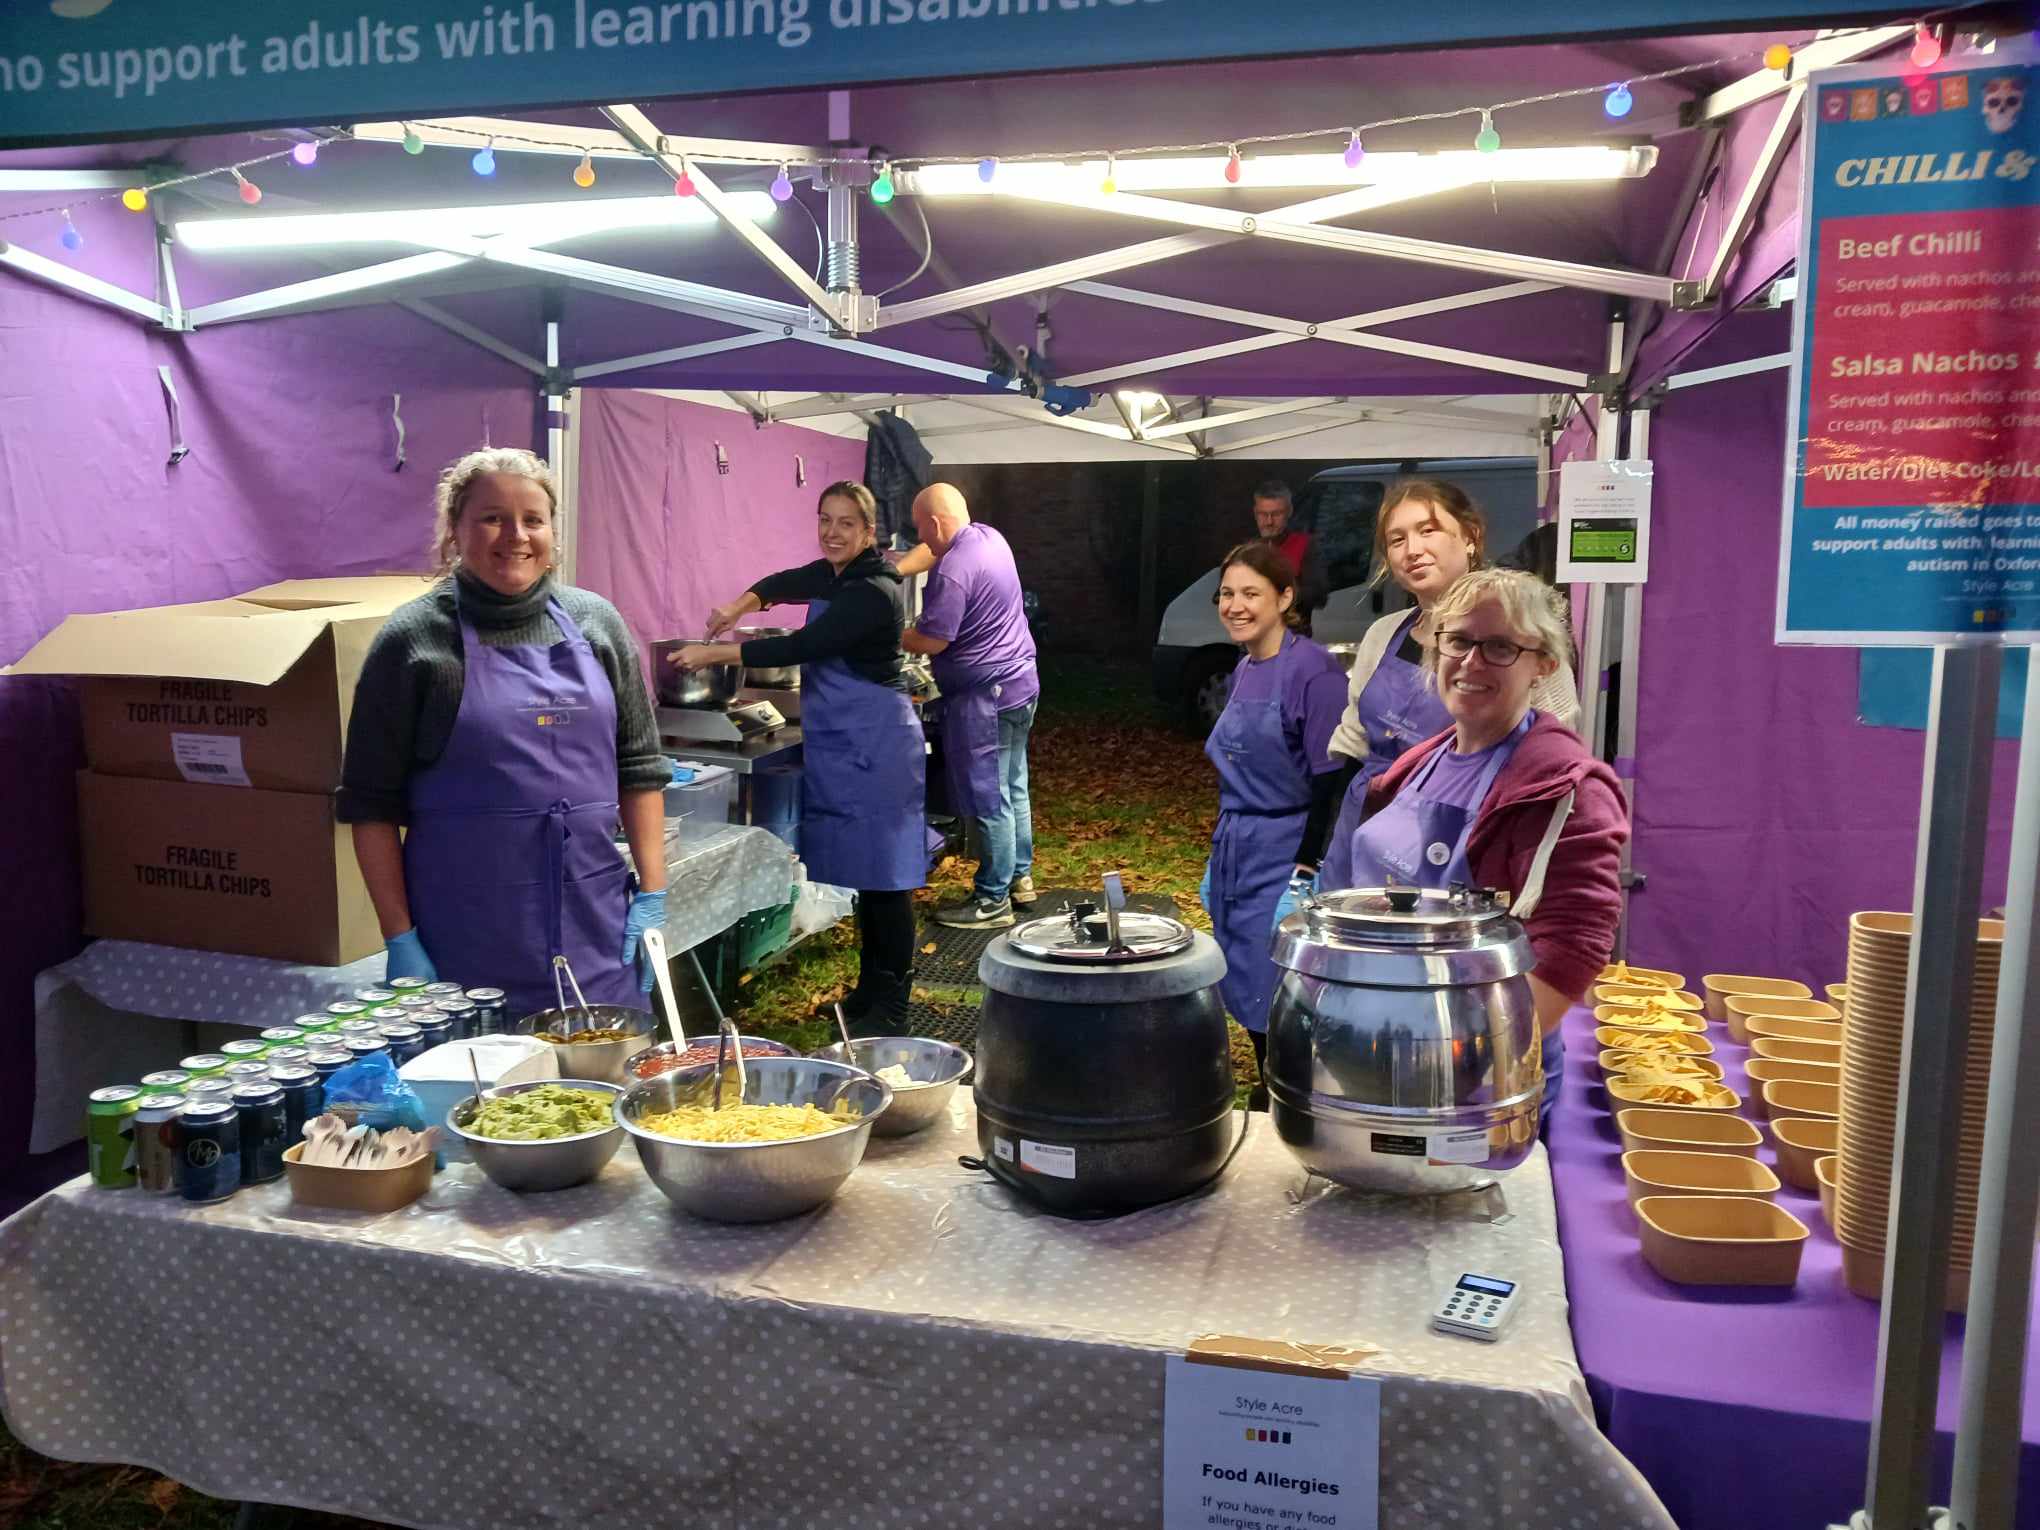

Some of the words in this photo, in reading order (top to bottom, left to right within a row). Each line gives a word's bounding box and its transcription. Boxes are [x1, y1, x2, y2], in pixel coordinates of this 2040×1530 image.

[58, 33, 247, 98] support
[261, 17, 420, 73] adults
[435, 2, 556, 59] with
[575, 0, 812, 48] learning
[1835, 151, 1993, 188] CHILLI
[1995, 150, 2038, 180] &
[1839, 234, 1901, 260] Beef
[1908, 230, 1982, 256] Chilli
[1836, 274, 1898, 293] Served
[1902, 271, 1942, 289] with
[1946, 270, 2012, 287] nachos
[1830, 355, 1904, 378] Salsa
[1911, 350, 2019, 374] Nachos
[1828, 391, 1889, 409] Served
[1893, 390, 1933, 406] with
[1938, 387, 2004, 404] nachos
[1827, 418, 1887, 433] cream,
[1835, 515, 1856, 529] All
[1862, 516, 1920, 533] money
[1925, 513, 1979, 528] raised
[1982, 515, 2022, 531] goes
[1812, 537, 1878, 553] support
[1883, 535, 1936, 550] adults
[1942, 535, 1982, 550] with
[1907, 557, 1968, 572] autism
[1973, 557, 1989, 571] in
[1962, 579, 1997, 593] Style
[160, 681, 232, 701] FRAGILE
[127, 703, 209, 725] TORTILLA
[214, 705, 267, 727] CHIPS
[166, 845, 237, 870] FRAGILE
[134, 864, 215, 892] TORTILLA
[219, 874, 272, 897] CHIPS
[1235, 1396, 1267, 1412] Style
[1271, 1402, 1303, 1416] Acre
[1202, 1463, 1247, 1482] Food
[1254, 1471, 1340, 1495] Allergies
[1202, 1495, 1212, 1507] If
[1216, 1500, 1239, 1512] you
[1243, 1501, 1275, 1517] have
[1279, 1509, 1303, 1523] any
[1307, 1511, 1336, 1526] food
[1207, 1513, 1261, 1530] allergies
